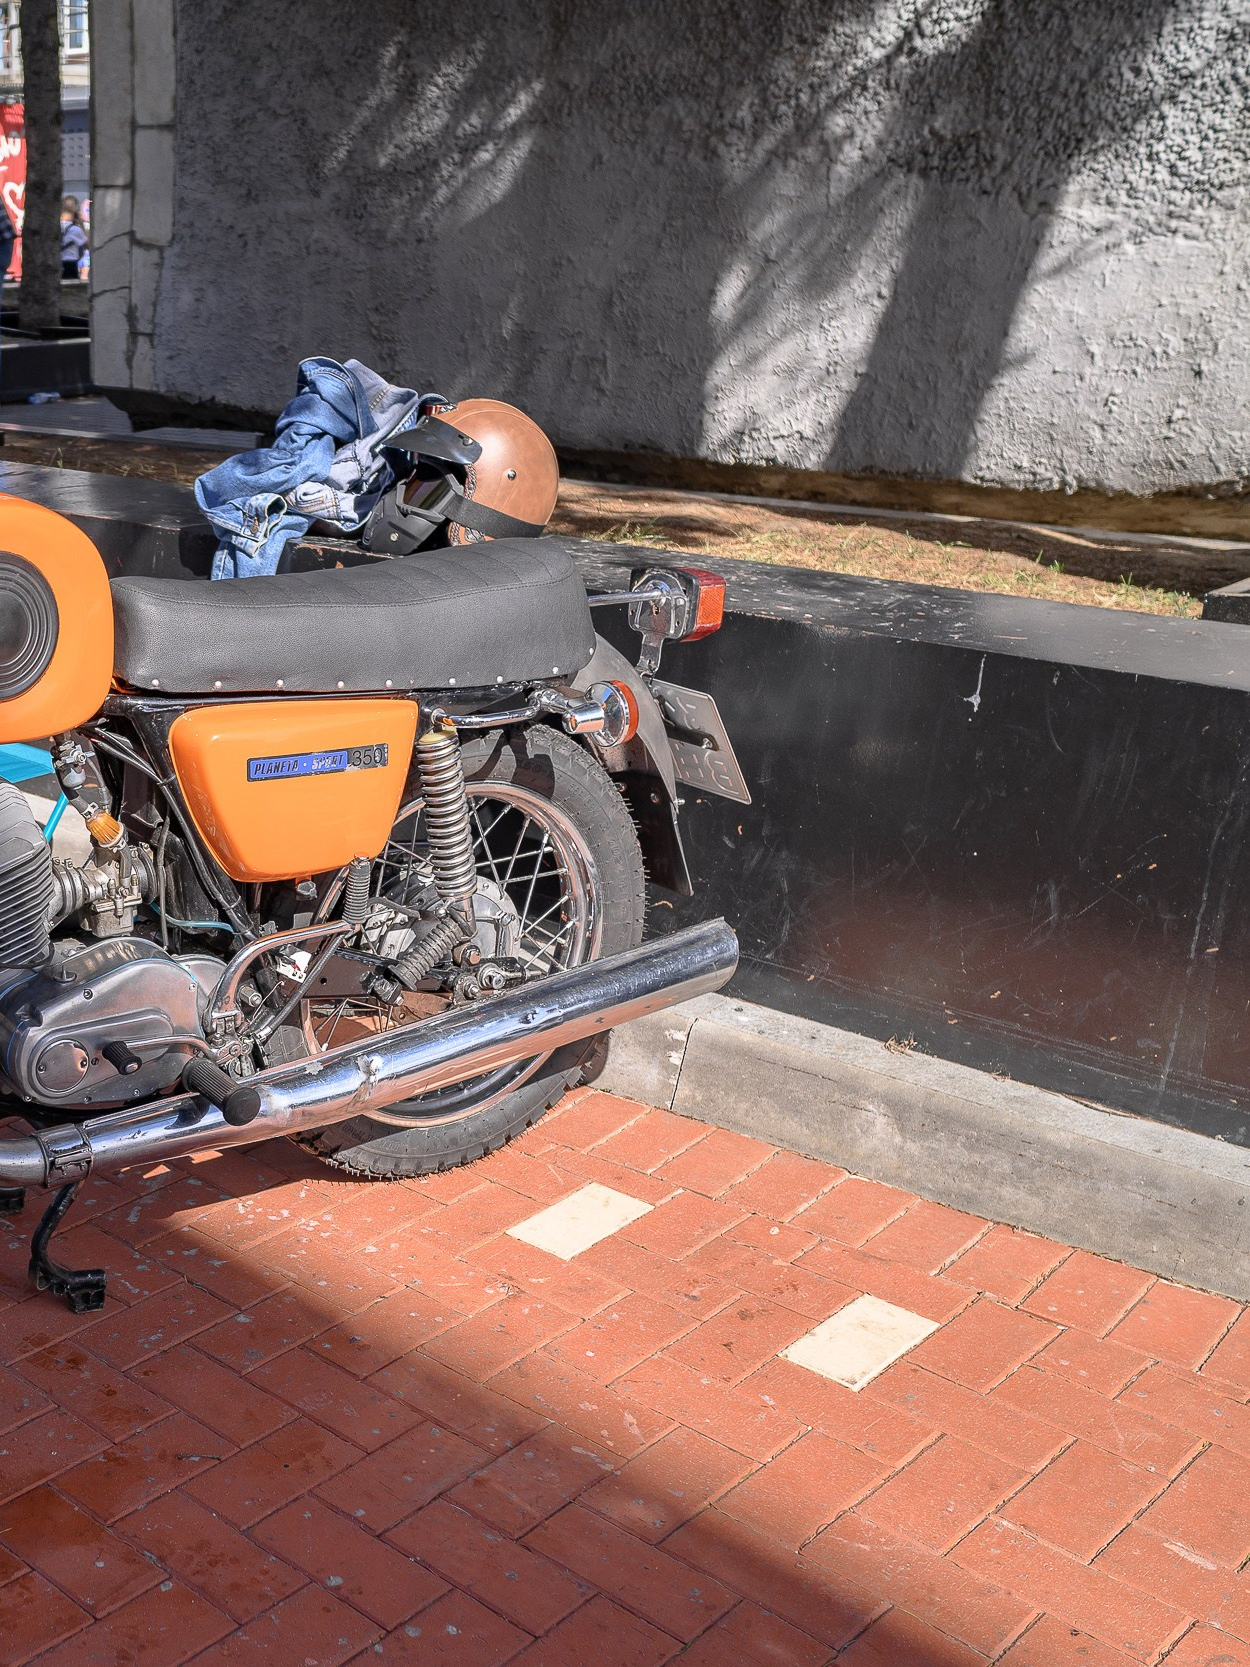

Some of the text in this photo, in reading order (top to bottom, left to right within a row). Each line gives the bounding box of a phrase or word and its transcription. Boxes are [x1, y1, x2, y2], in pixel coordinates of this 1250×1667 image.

[254, 748, 383, 776] PLANETA SPORT 350
